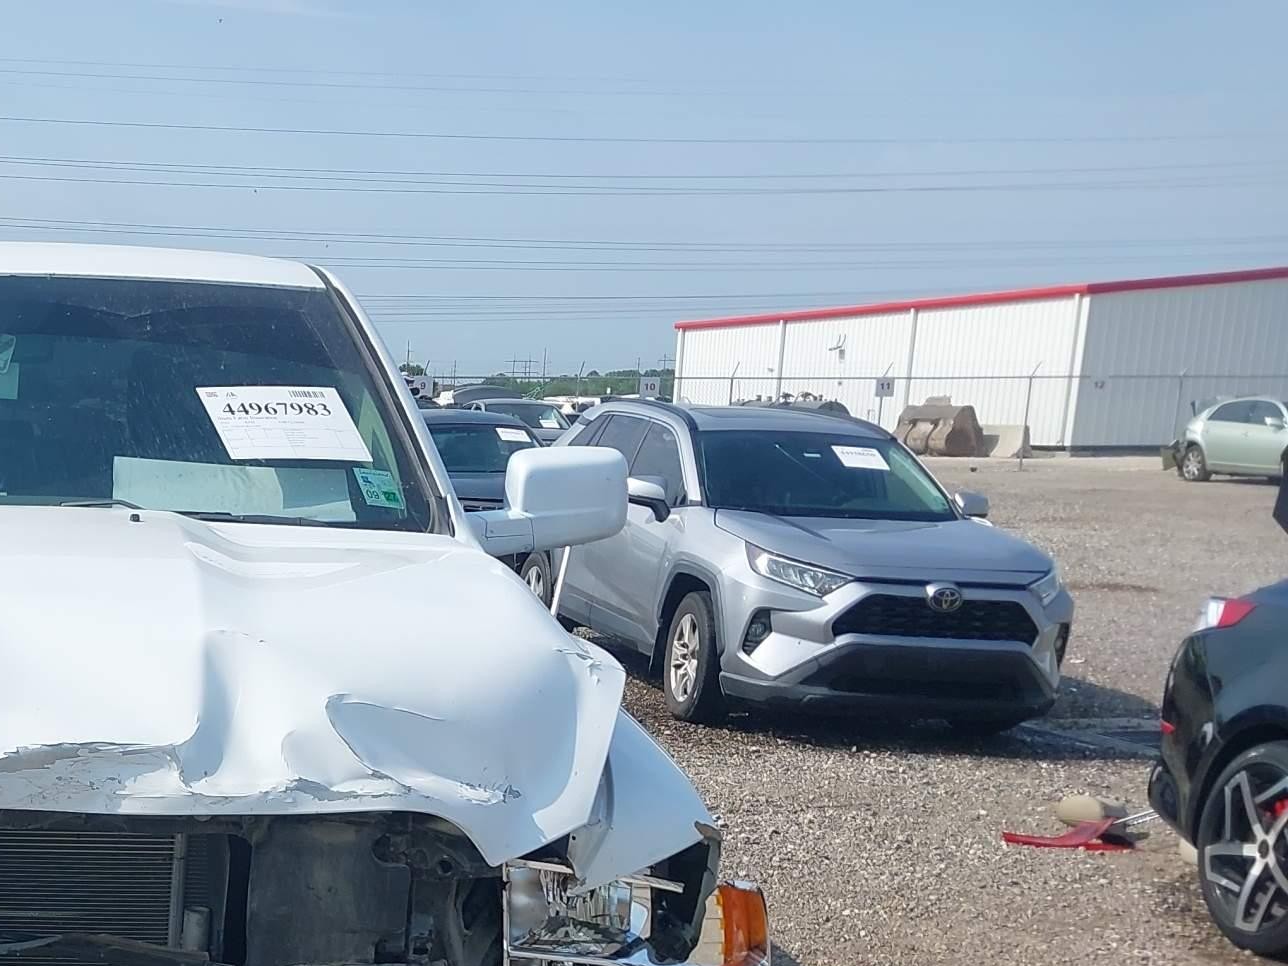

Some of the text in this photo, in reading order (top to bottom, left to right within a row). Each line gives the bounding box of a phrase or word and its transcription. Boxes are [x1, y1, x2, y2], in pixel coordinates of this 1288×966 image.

[644, 383, 656, 391] 10
[880, 382, 891, 390] 11
[222, 402, 332, 416] 44967983
[366, 489, 380, 499] 09
